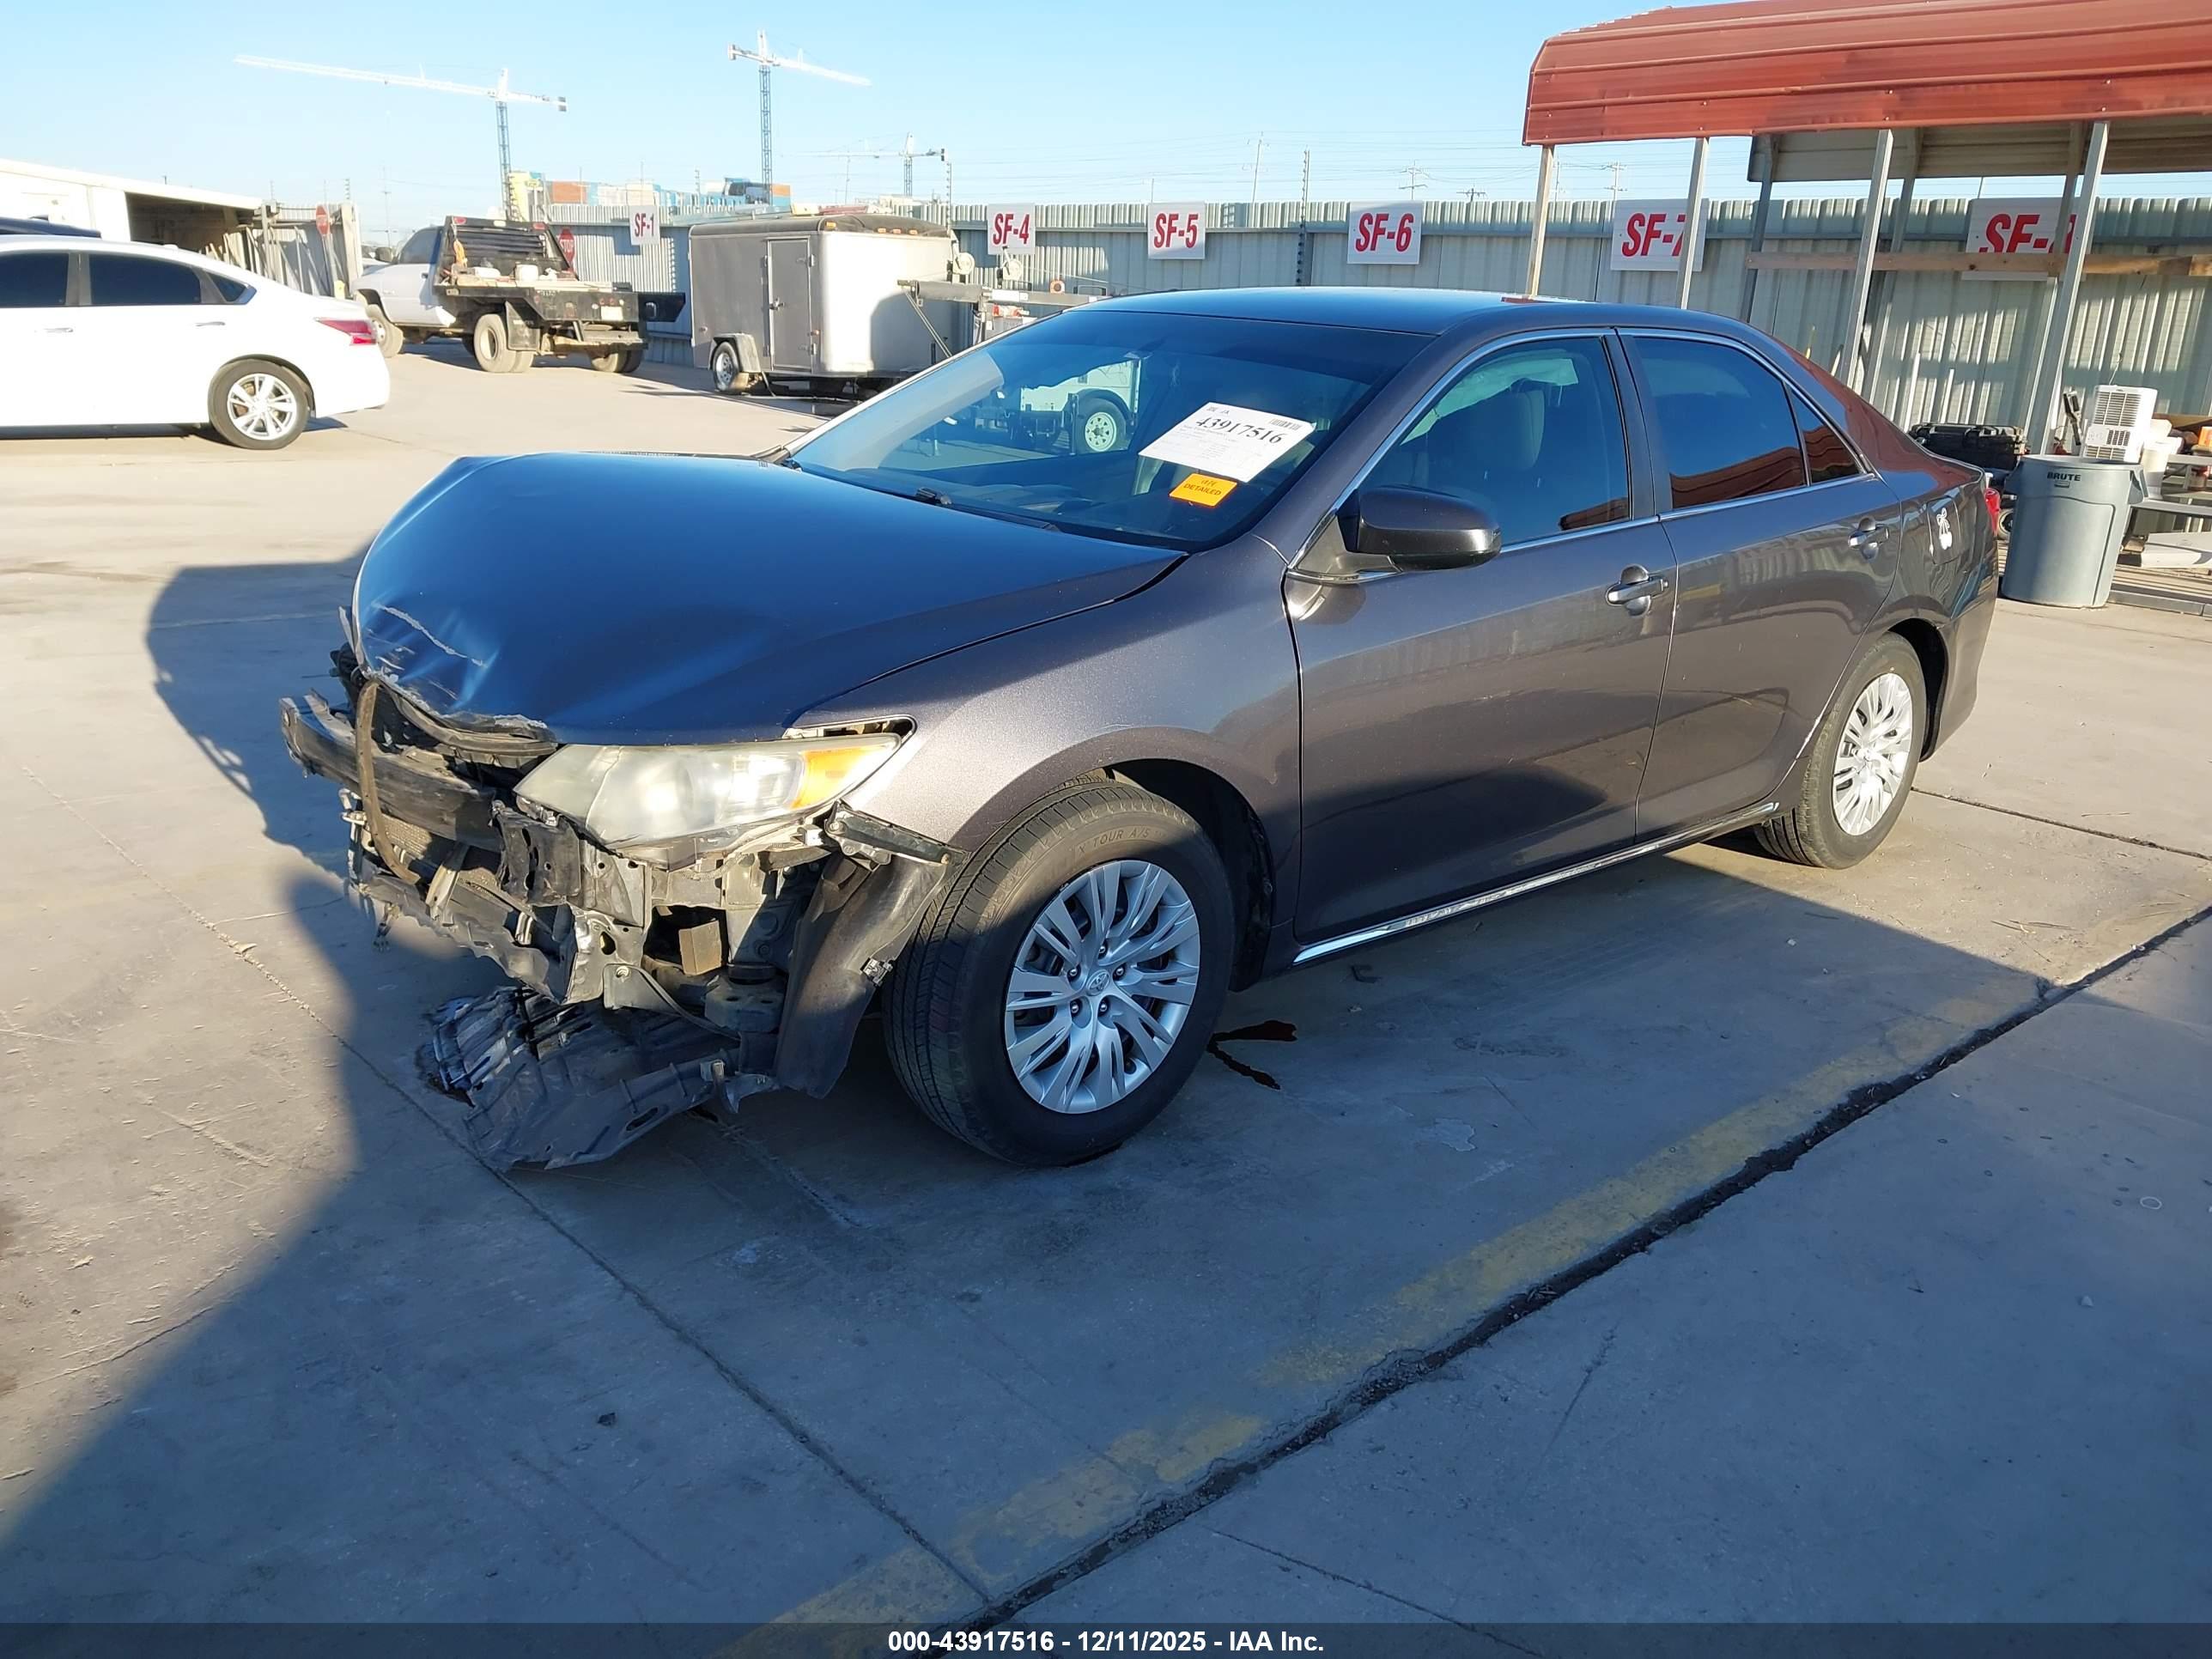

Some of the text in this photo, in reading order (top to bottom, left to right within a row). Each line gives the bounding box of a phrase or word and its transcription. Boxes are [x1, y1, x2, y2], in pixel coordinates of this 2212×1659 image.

[635, 213, 654, 237] SF-1
[993, 213, 1030, 246] SF-4
[1153, 213, 1199, 249] SF-5
[1355, 212, 1414, 252] SF-6
[1195, 416, 1286, 444] 43917516
[1183, 483, 1222, 496] DETAILED
[2047, 471, 2082, 482] BRUTE
[1094, 829, 1124, 848] TOUR
